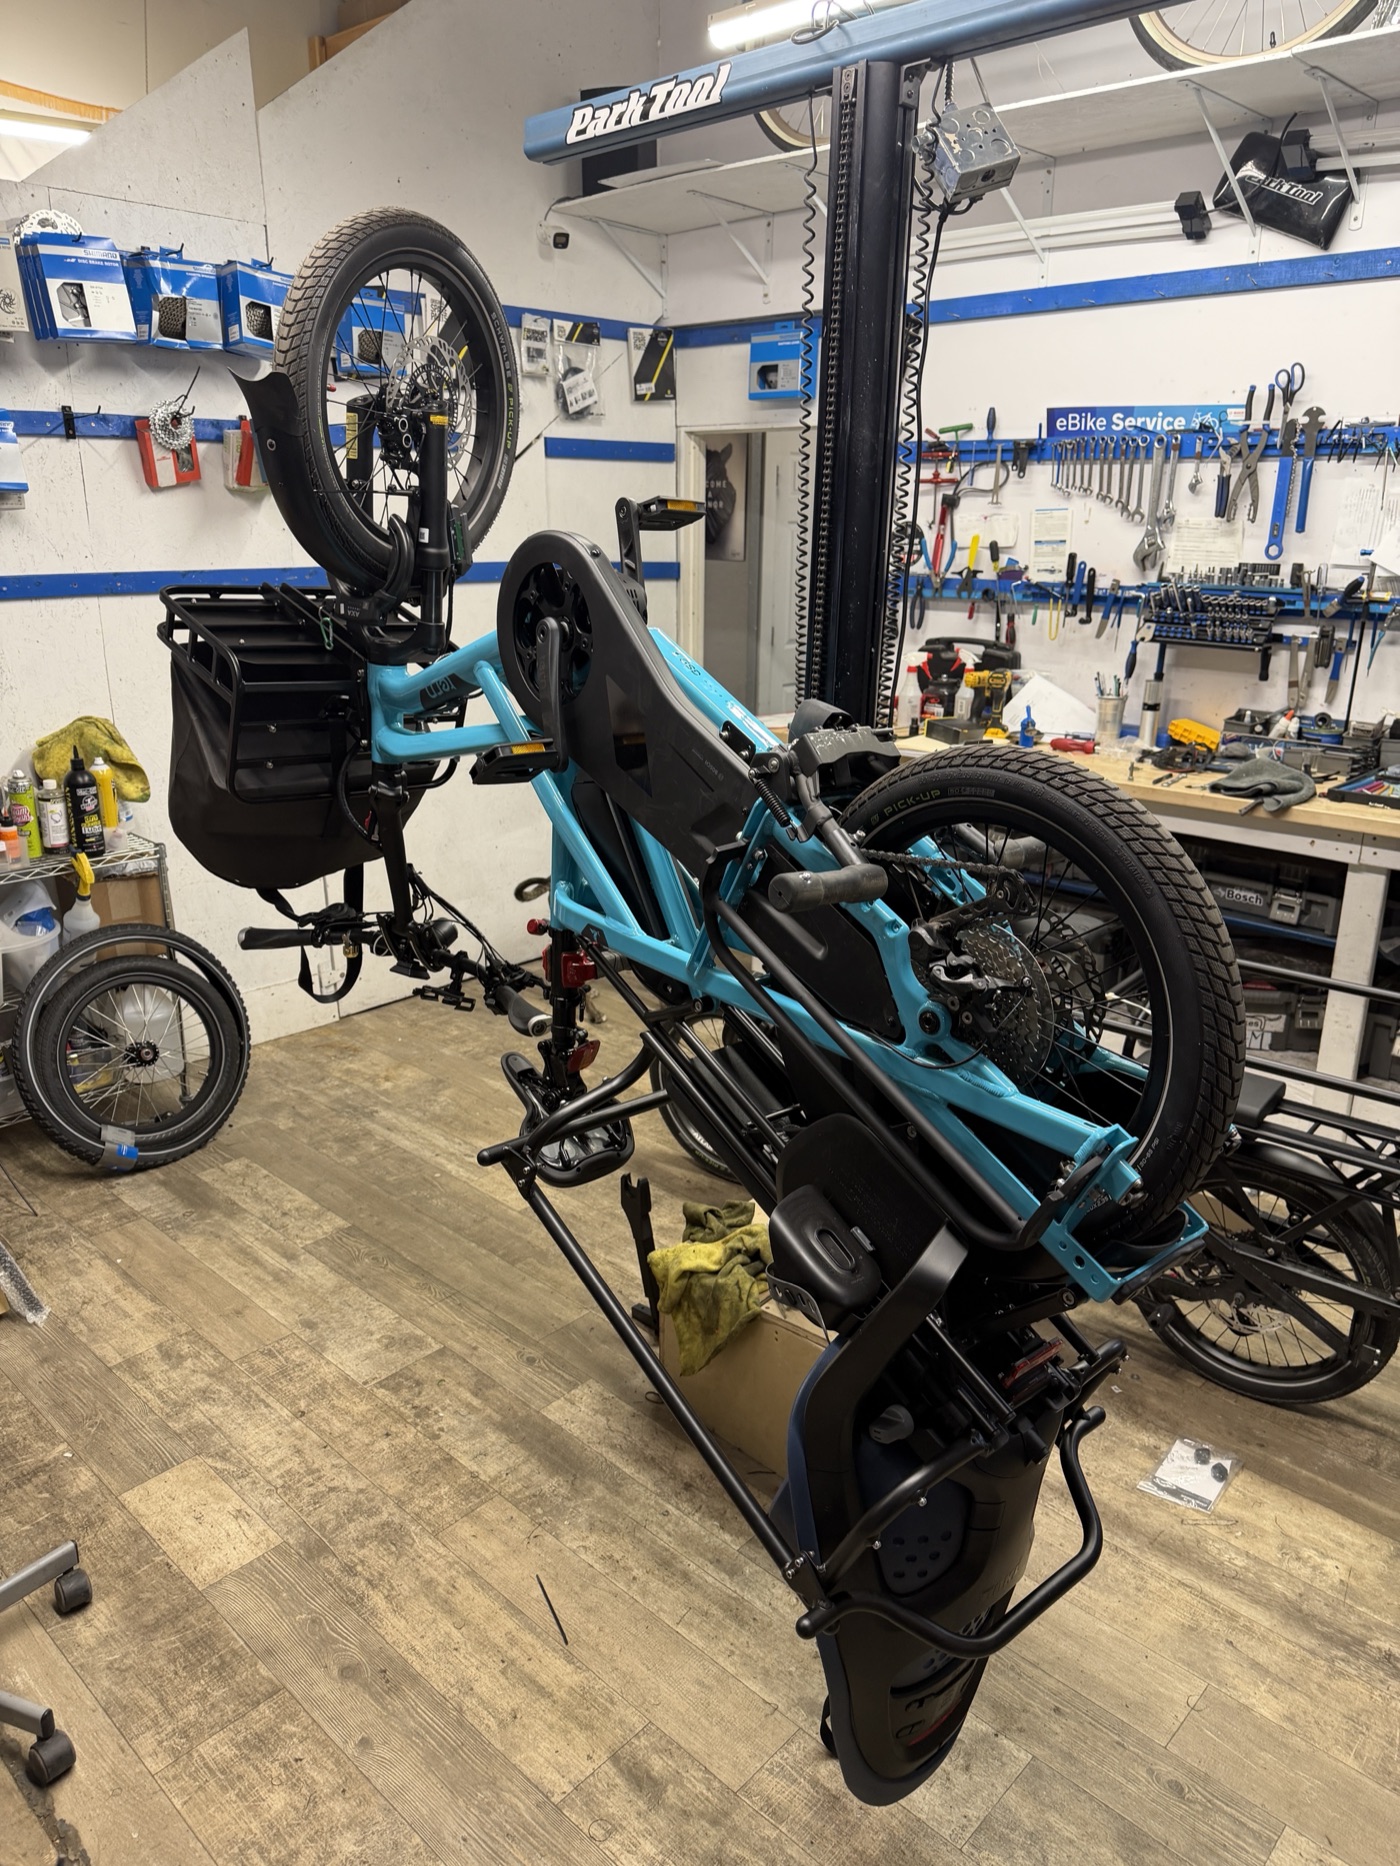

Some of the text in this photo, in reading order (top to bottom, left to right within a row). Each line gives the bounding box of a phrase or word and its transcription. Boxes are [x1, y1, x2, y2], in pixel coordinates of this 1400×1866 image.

[565, 60, 733, 145] Park Tool
[1285, 180, 1324, 206] Tool
[490, 311, 515, 449] SCHWALBE PICK-UP
[1055, 410, 1187, 433] eBike Service
[883, 788, 941, 817] PICK-UP
[1226, 889, 1263, 906] Bosch
